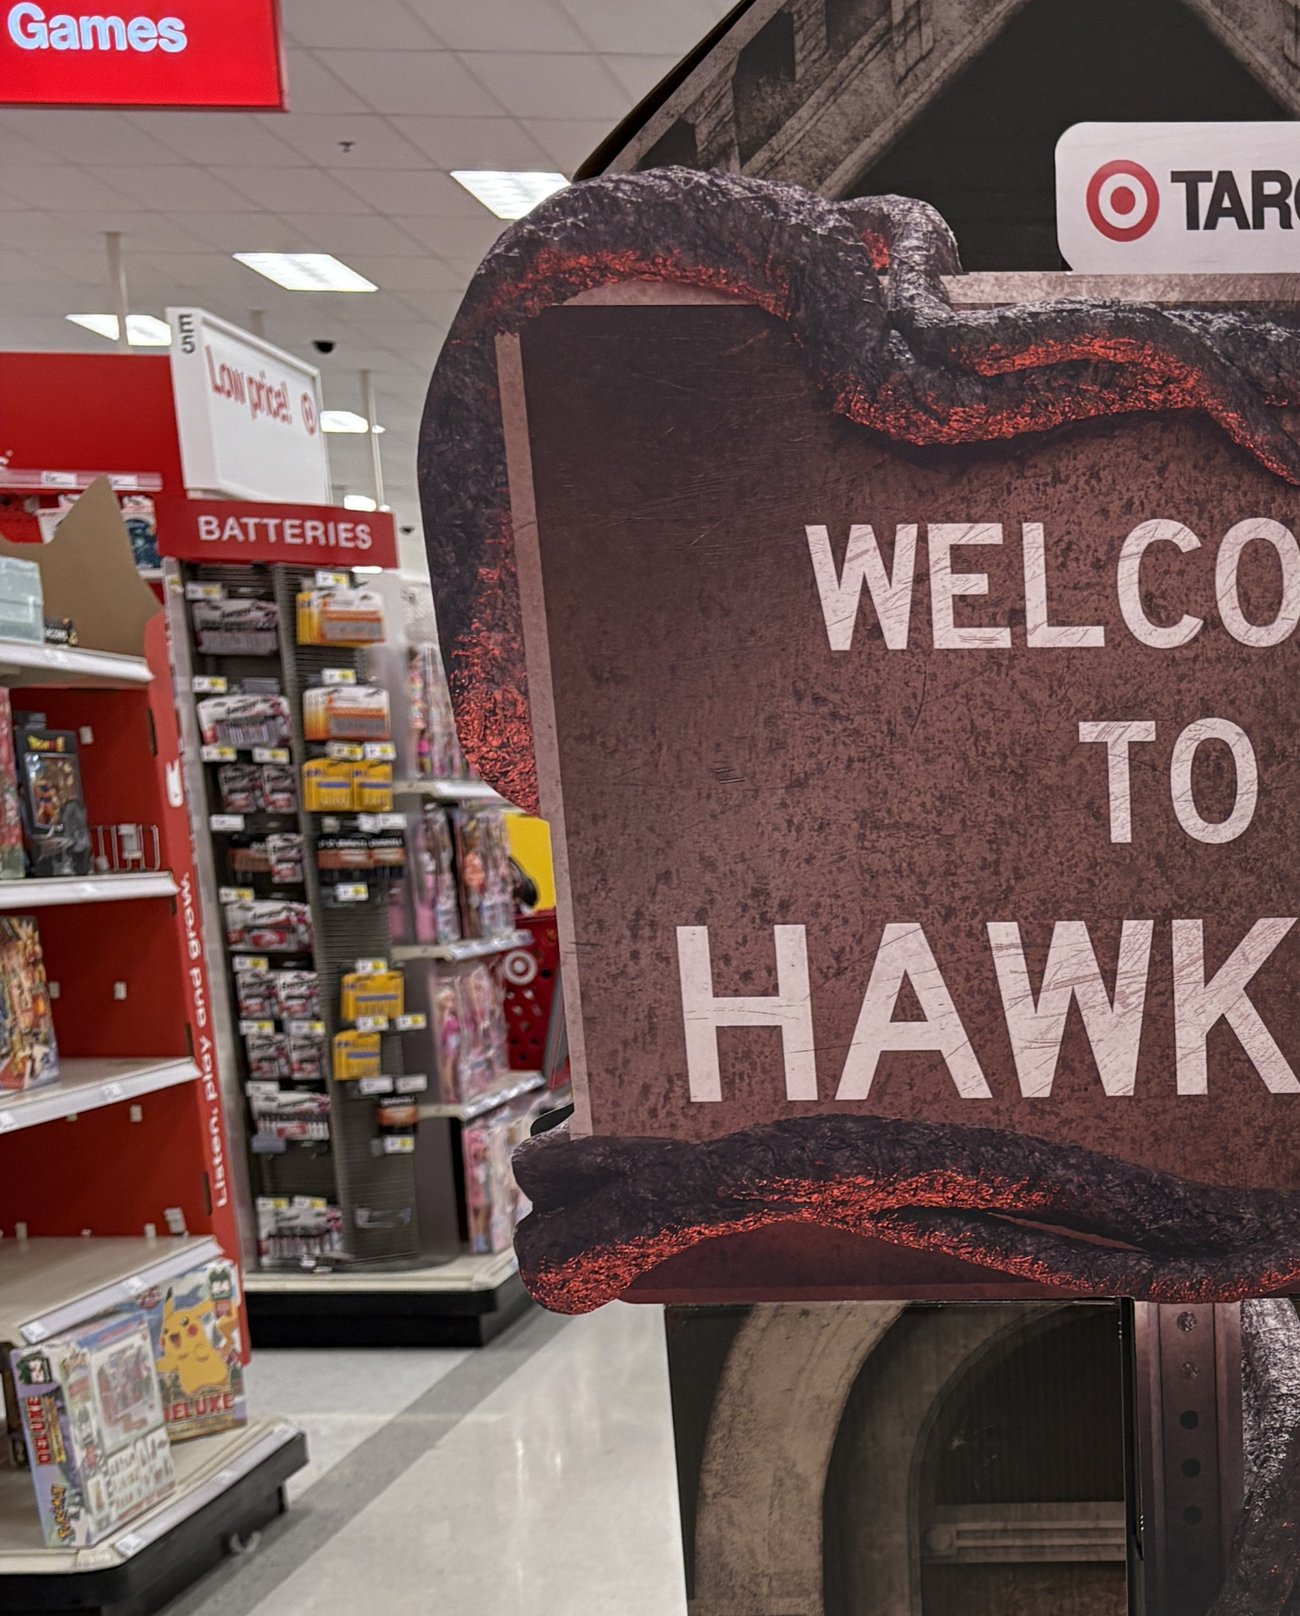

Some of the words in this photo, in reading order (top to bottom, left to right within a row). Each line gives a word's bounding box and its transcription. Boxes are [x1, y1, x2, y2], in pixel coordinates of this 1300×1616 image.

[7, 1, 187, 53] Games
[204, 344, 246, 405] Low
[197, 514, 373, 550] BATTERIES
[1078, 716, 1259, 845] TO
[189, 966, 208, 1028] and
[199, 1036, 218, 1102] play
